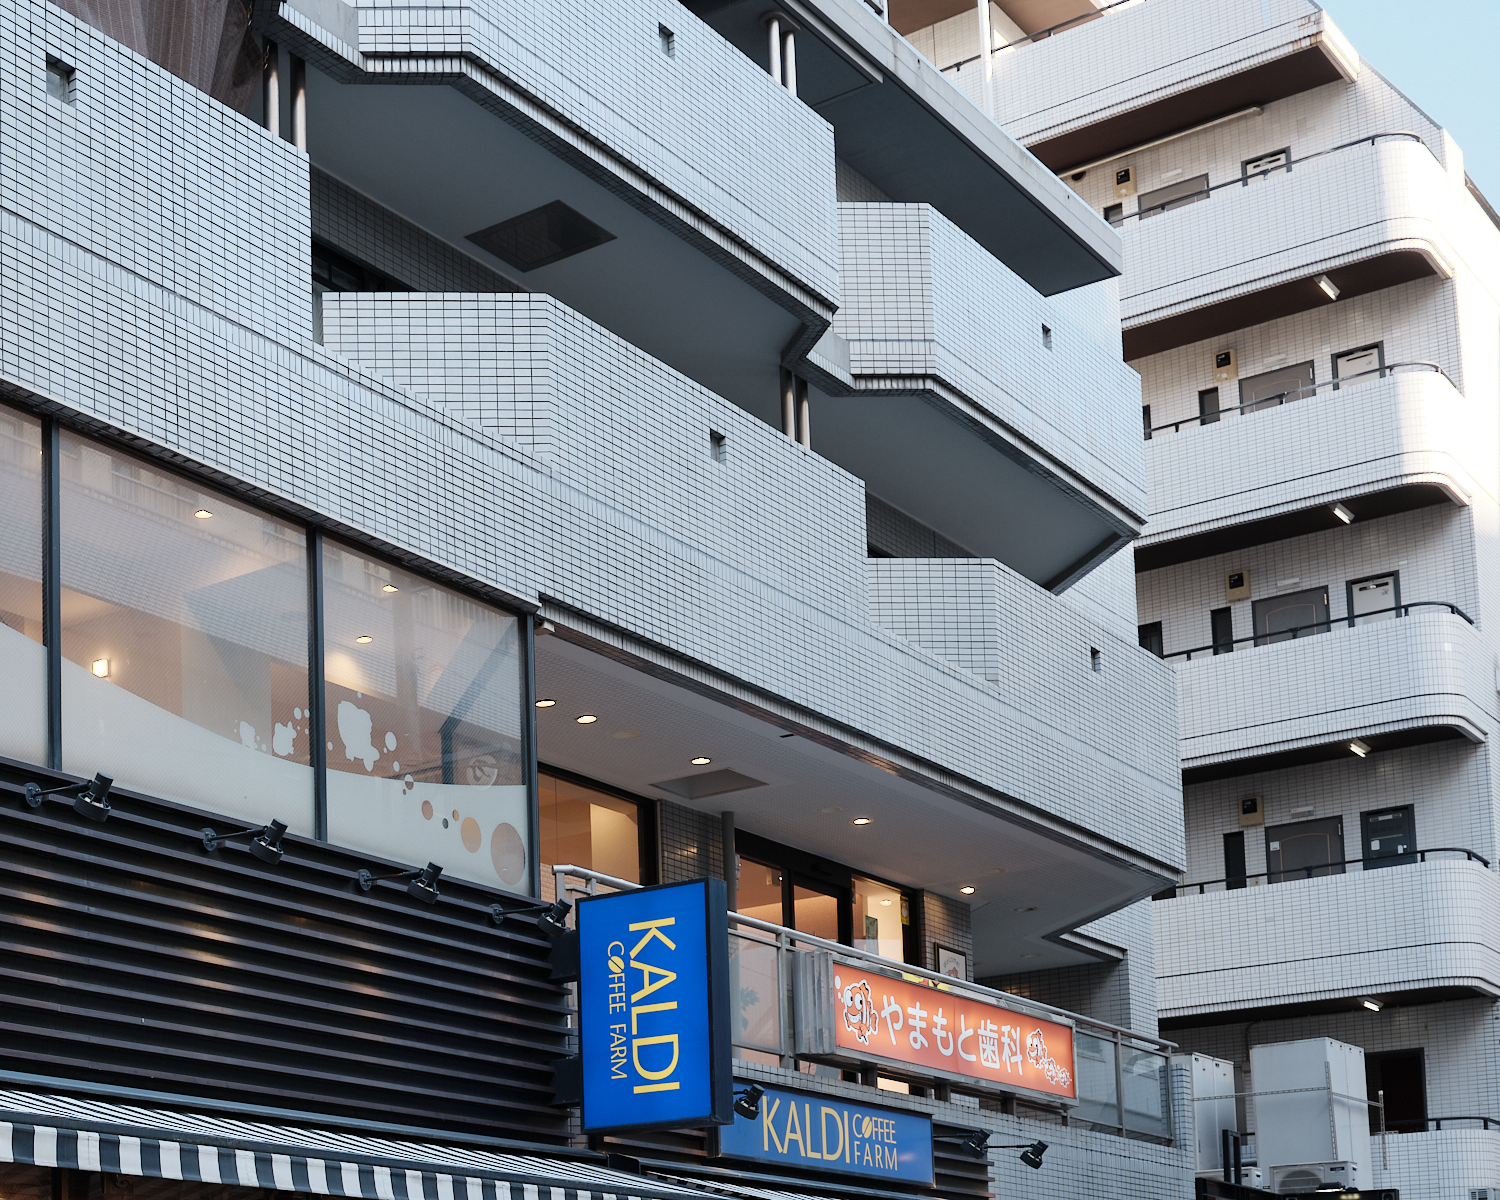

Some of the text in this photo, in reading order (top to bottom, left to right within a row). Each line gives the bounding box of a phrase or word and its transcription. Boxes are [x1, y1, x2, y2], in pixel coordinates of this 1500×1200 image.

[607, 940, 628, 1080] COFFEE FARM
[628, 916, 680, 1095] KALDI
[880, 993, 1023, 1077] やまもと歯科
[762, 1096, 850, 1164] KALDI
[852, 1114, 897, 1145] COFFEE
[853, 1140, 898, 1171] FARM
